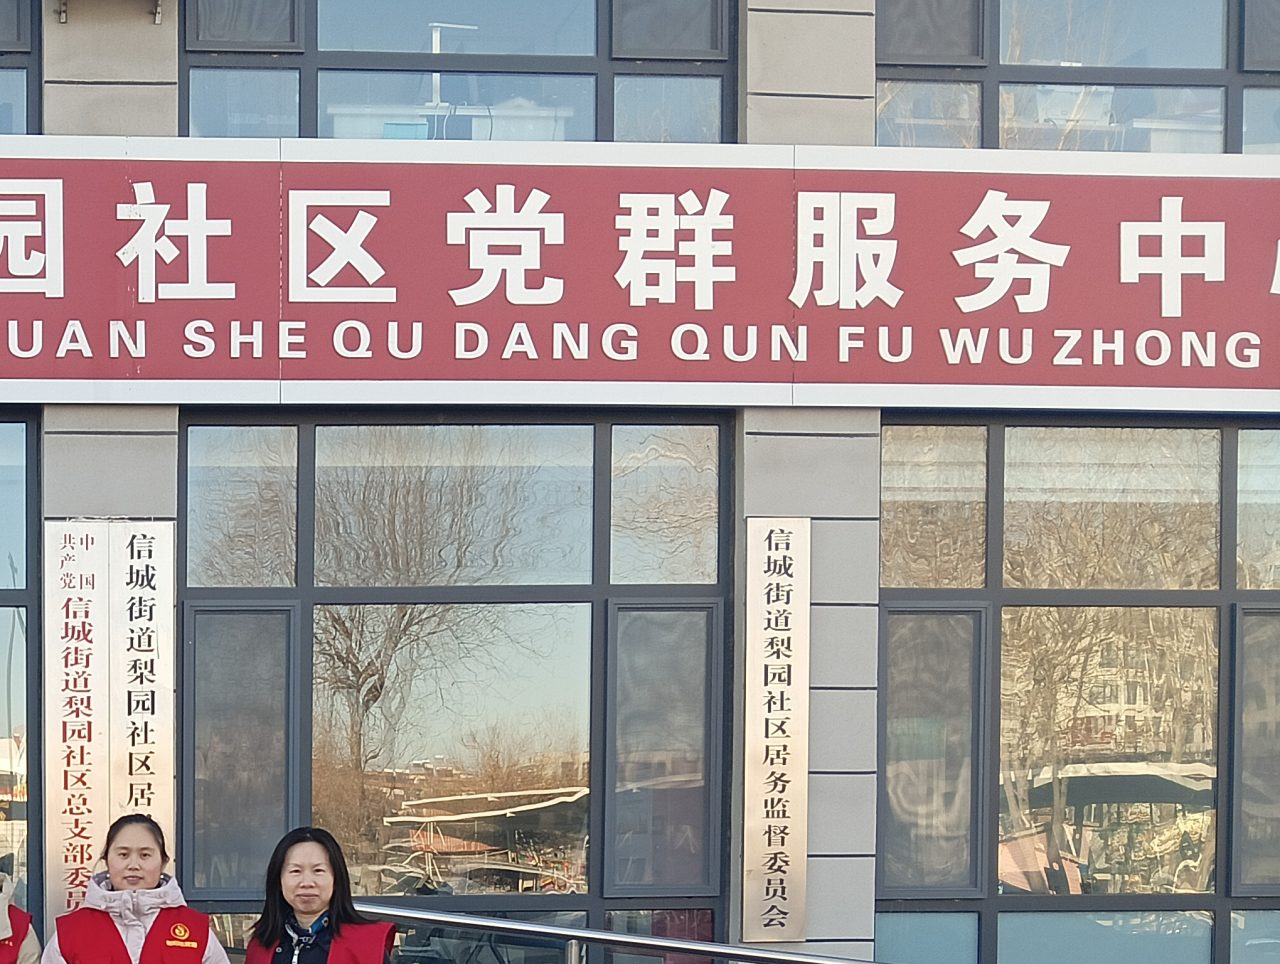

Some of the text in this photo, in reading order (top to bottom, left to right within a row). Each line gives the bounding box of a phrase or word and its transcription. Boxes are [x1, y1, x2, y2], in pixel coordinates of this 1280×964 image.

[455, 322, 639, 362] DANG
[670, 323, 808, 365] QUN
[839, 325, 913, 364] FU
[940, 327, 1035, 366] WU
[1053, 328, 1262, 369] ZHONG
[126, 533, 157, 820] 信城街道梨园社区居
[760, 528, 794, 929] 信城街道梨园社区居务监督委员会
